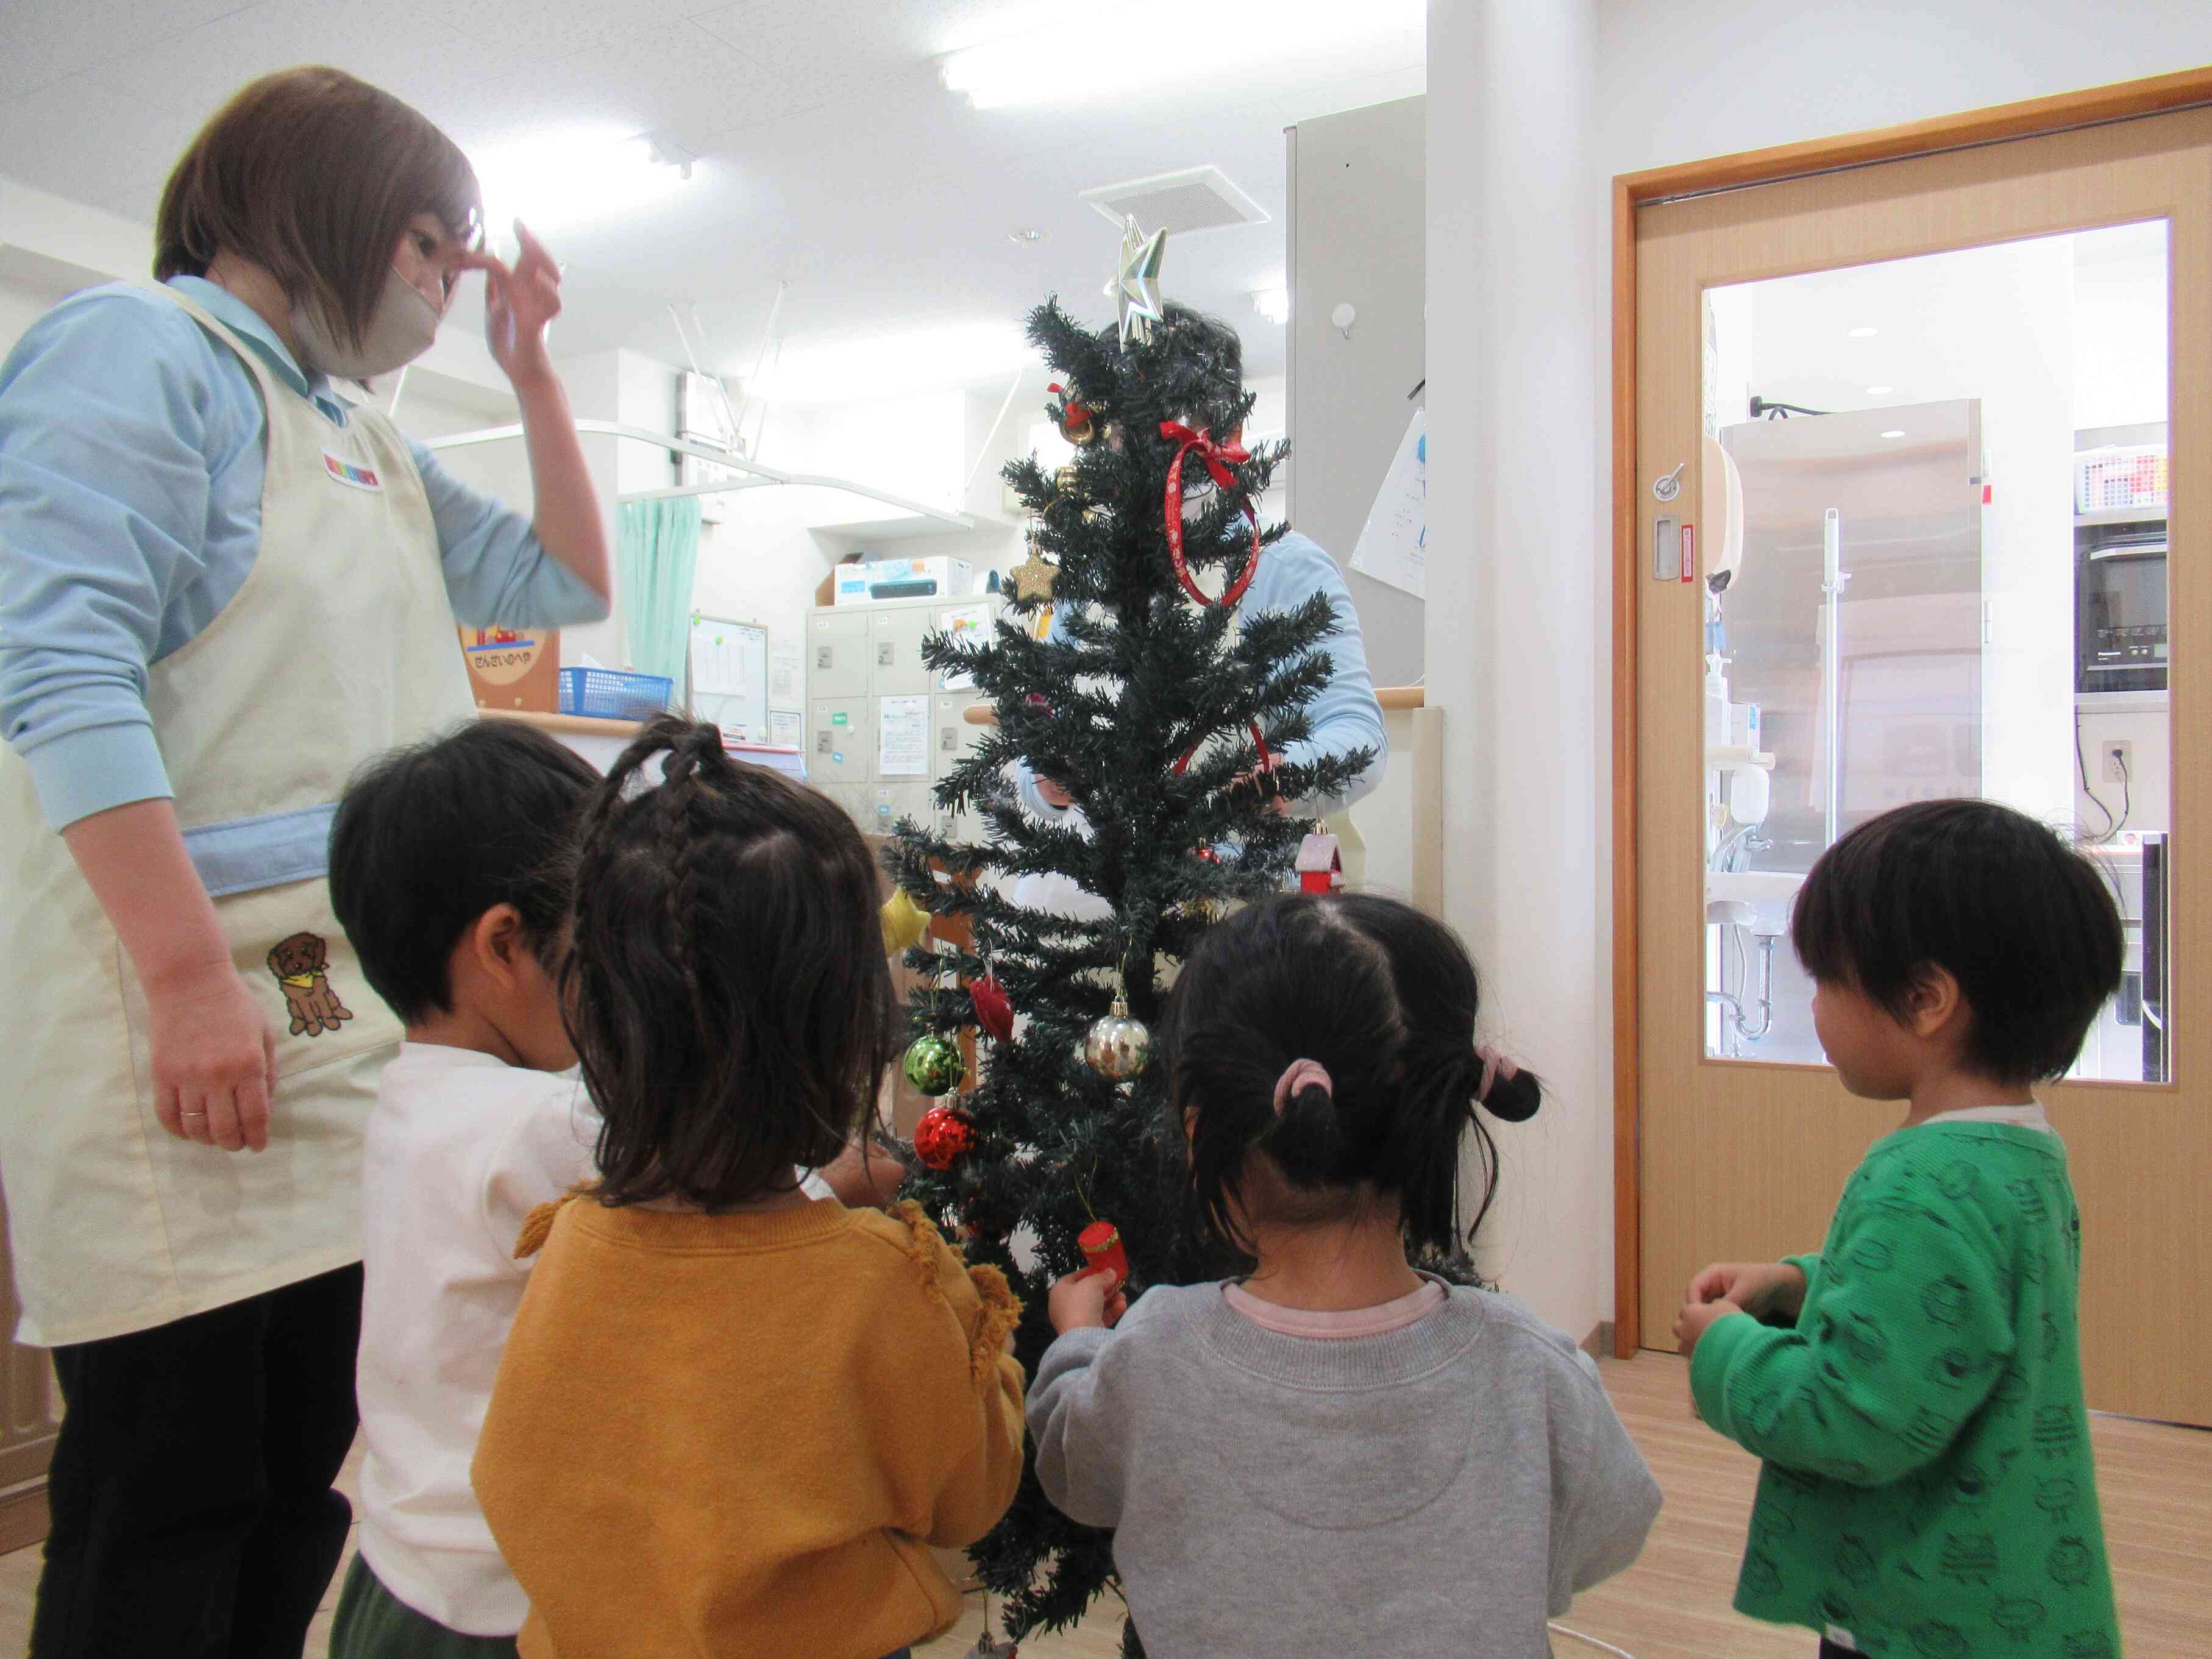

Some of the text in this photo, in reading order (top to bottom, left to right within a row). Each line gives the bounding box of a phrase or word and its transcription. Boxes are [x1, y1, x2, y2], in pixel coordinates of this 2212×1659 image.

[475, 652, 532, 668] せんせいのへや
